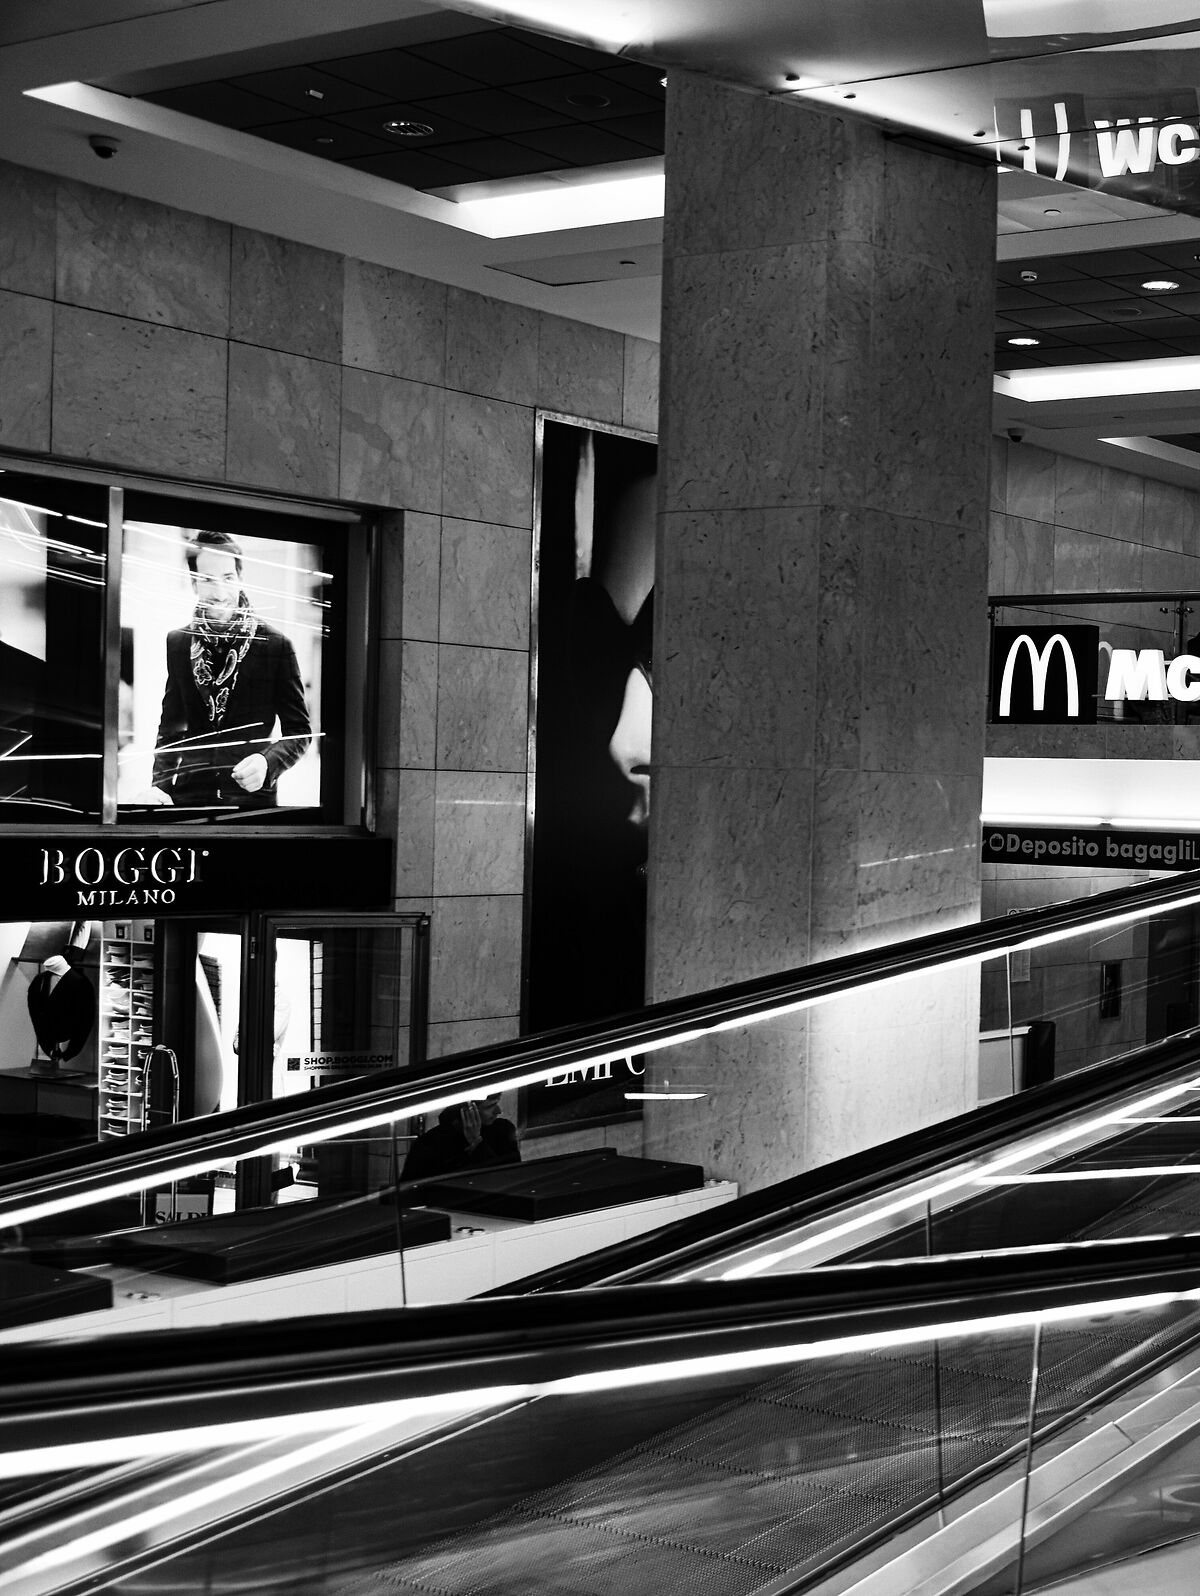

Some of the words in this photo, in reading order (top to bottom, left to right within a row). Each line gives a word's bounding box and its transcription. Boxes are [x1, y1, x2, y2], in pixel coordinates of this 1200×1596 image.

[1006, 833, 1099, 860] Deposito
[1106, 837, 1191, 864] bagagli
[40, 847, 204, 886] BOGGI
[76, 888, 176, 907] MILANO
